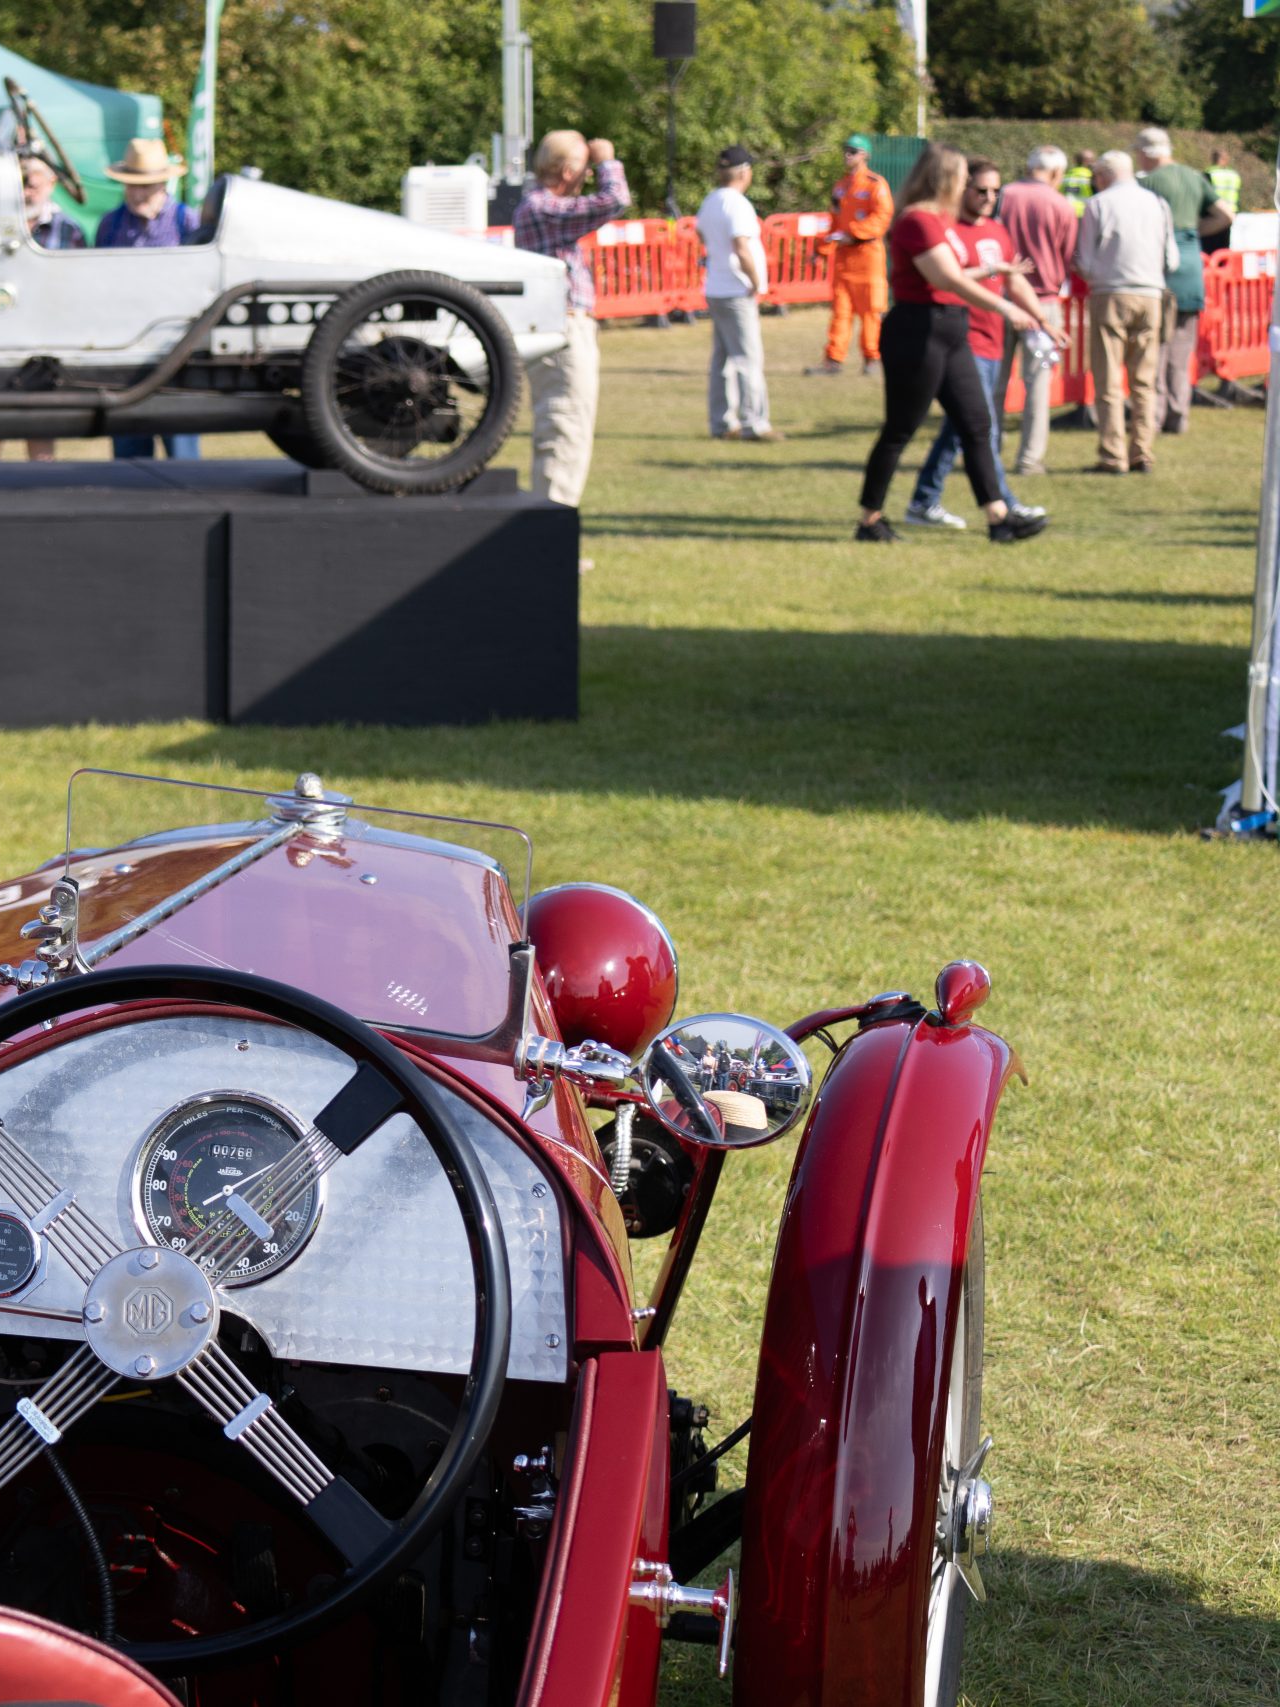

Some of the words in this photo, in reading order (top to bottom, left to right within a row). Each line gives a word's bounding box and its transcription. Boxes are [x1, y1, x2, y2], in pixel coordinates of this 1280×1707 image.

[183, 1111, 209, 1126] MILES
[260, 1113, 283, 1131] HOUR
[162, 1150, 177, 1161] 90
[213, 1145, 253, 1158] 00768
[152, 1180, 167, 1191] 80
[157, 1215, 172, 1226] 70
[285, 1211, 300, 1221] 20
[172, 1237, 187, 1249] 60
[263, 1242, 278, 1253] 30
[129, 1293, 167, 1330] MG
